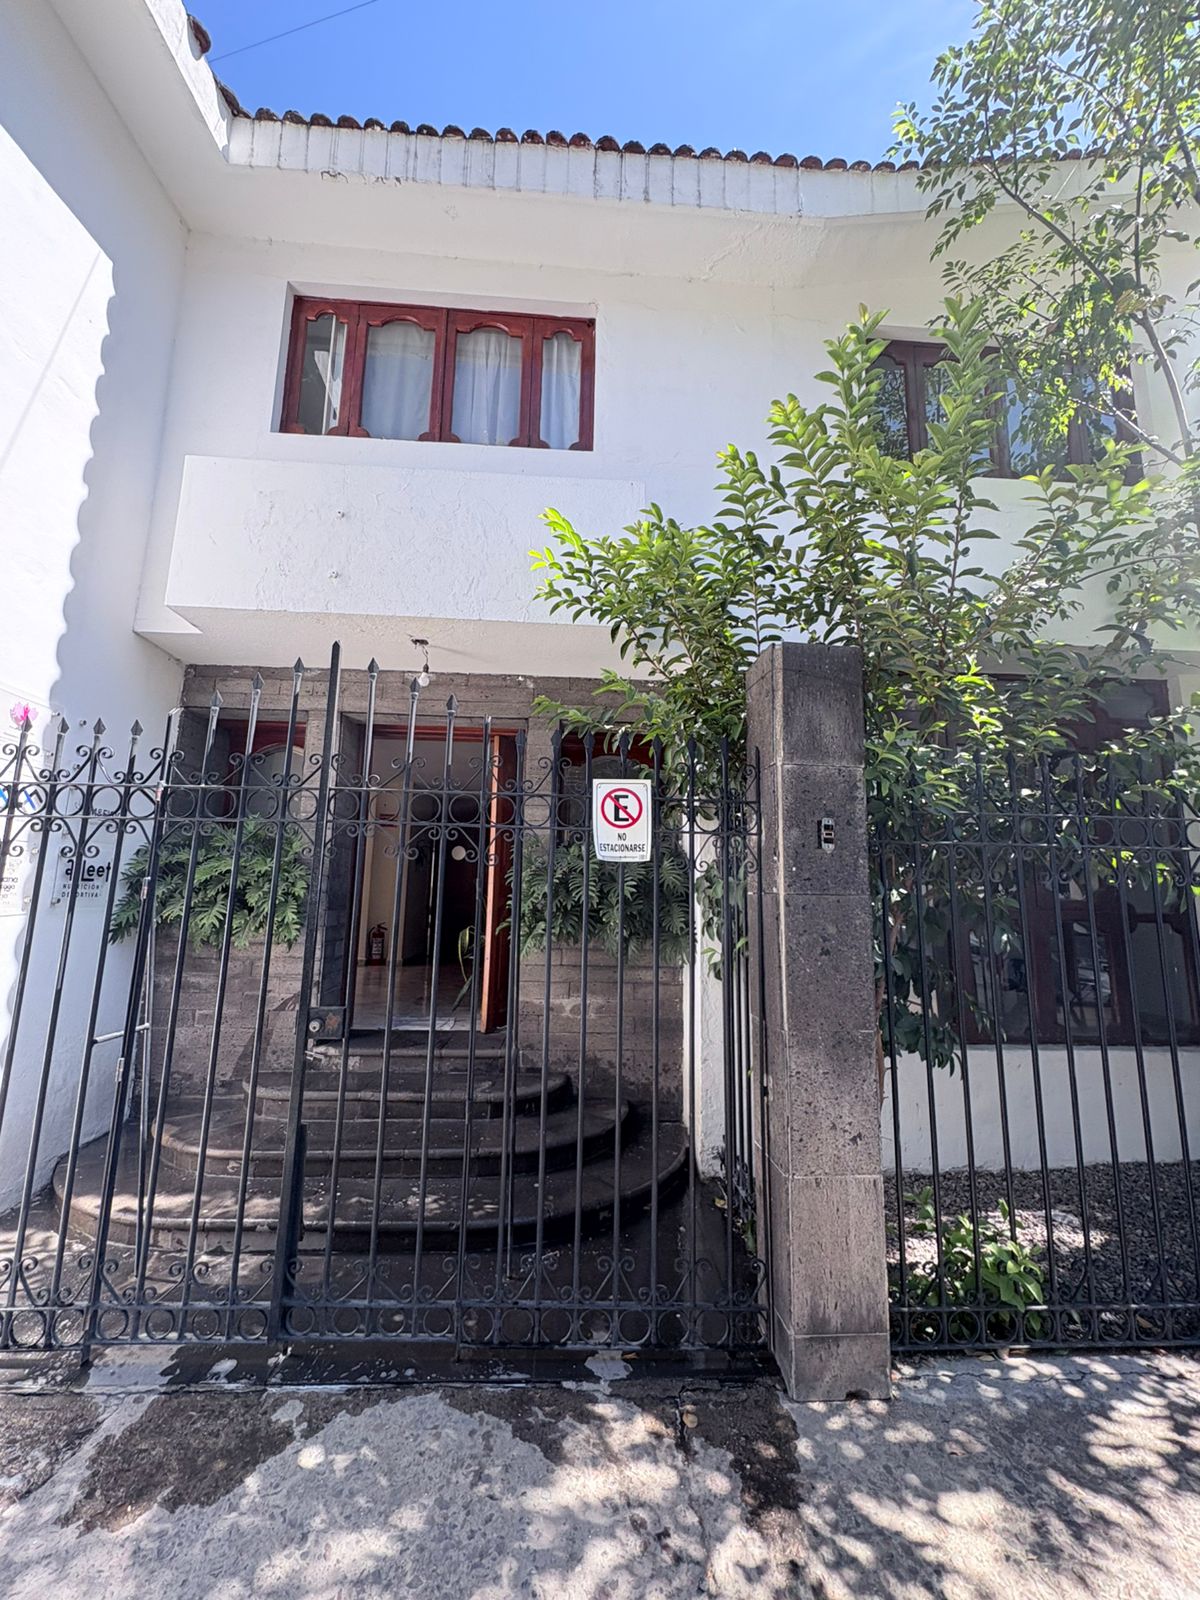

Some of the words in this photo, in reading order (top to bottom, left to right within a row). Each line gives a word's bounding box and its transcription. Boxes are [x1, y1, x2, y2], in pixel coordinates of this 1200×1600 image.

[614, 795, 629, 821] E
[617, 832, 627, 842] NO
[599, 843, 646, 852] ESTACIONARSE
